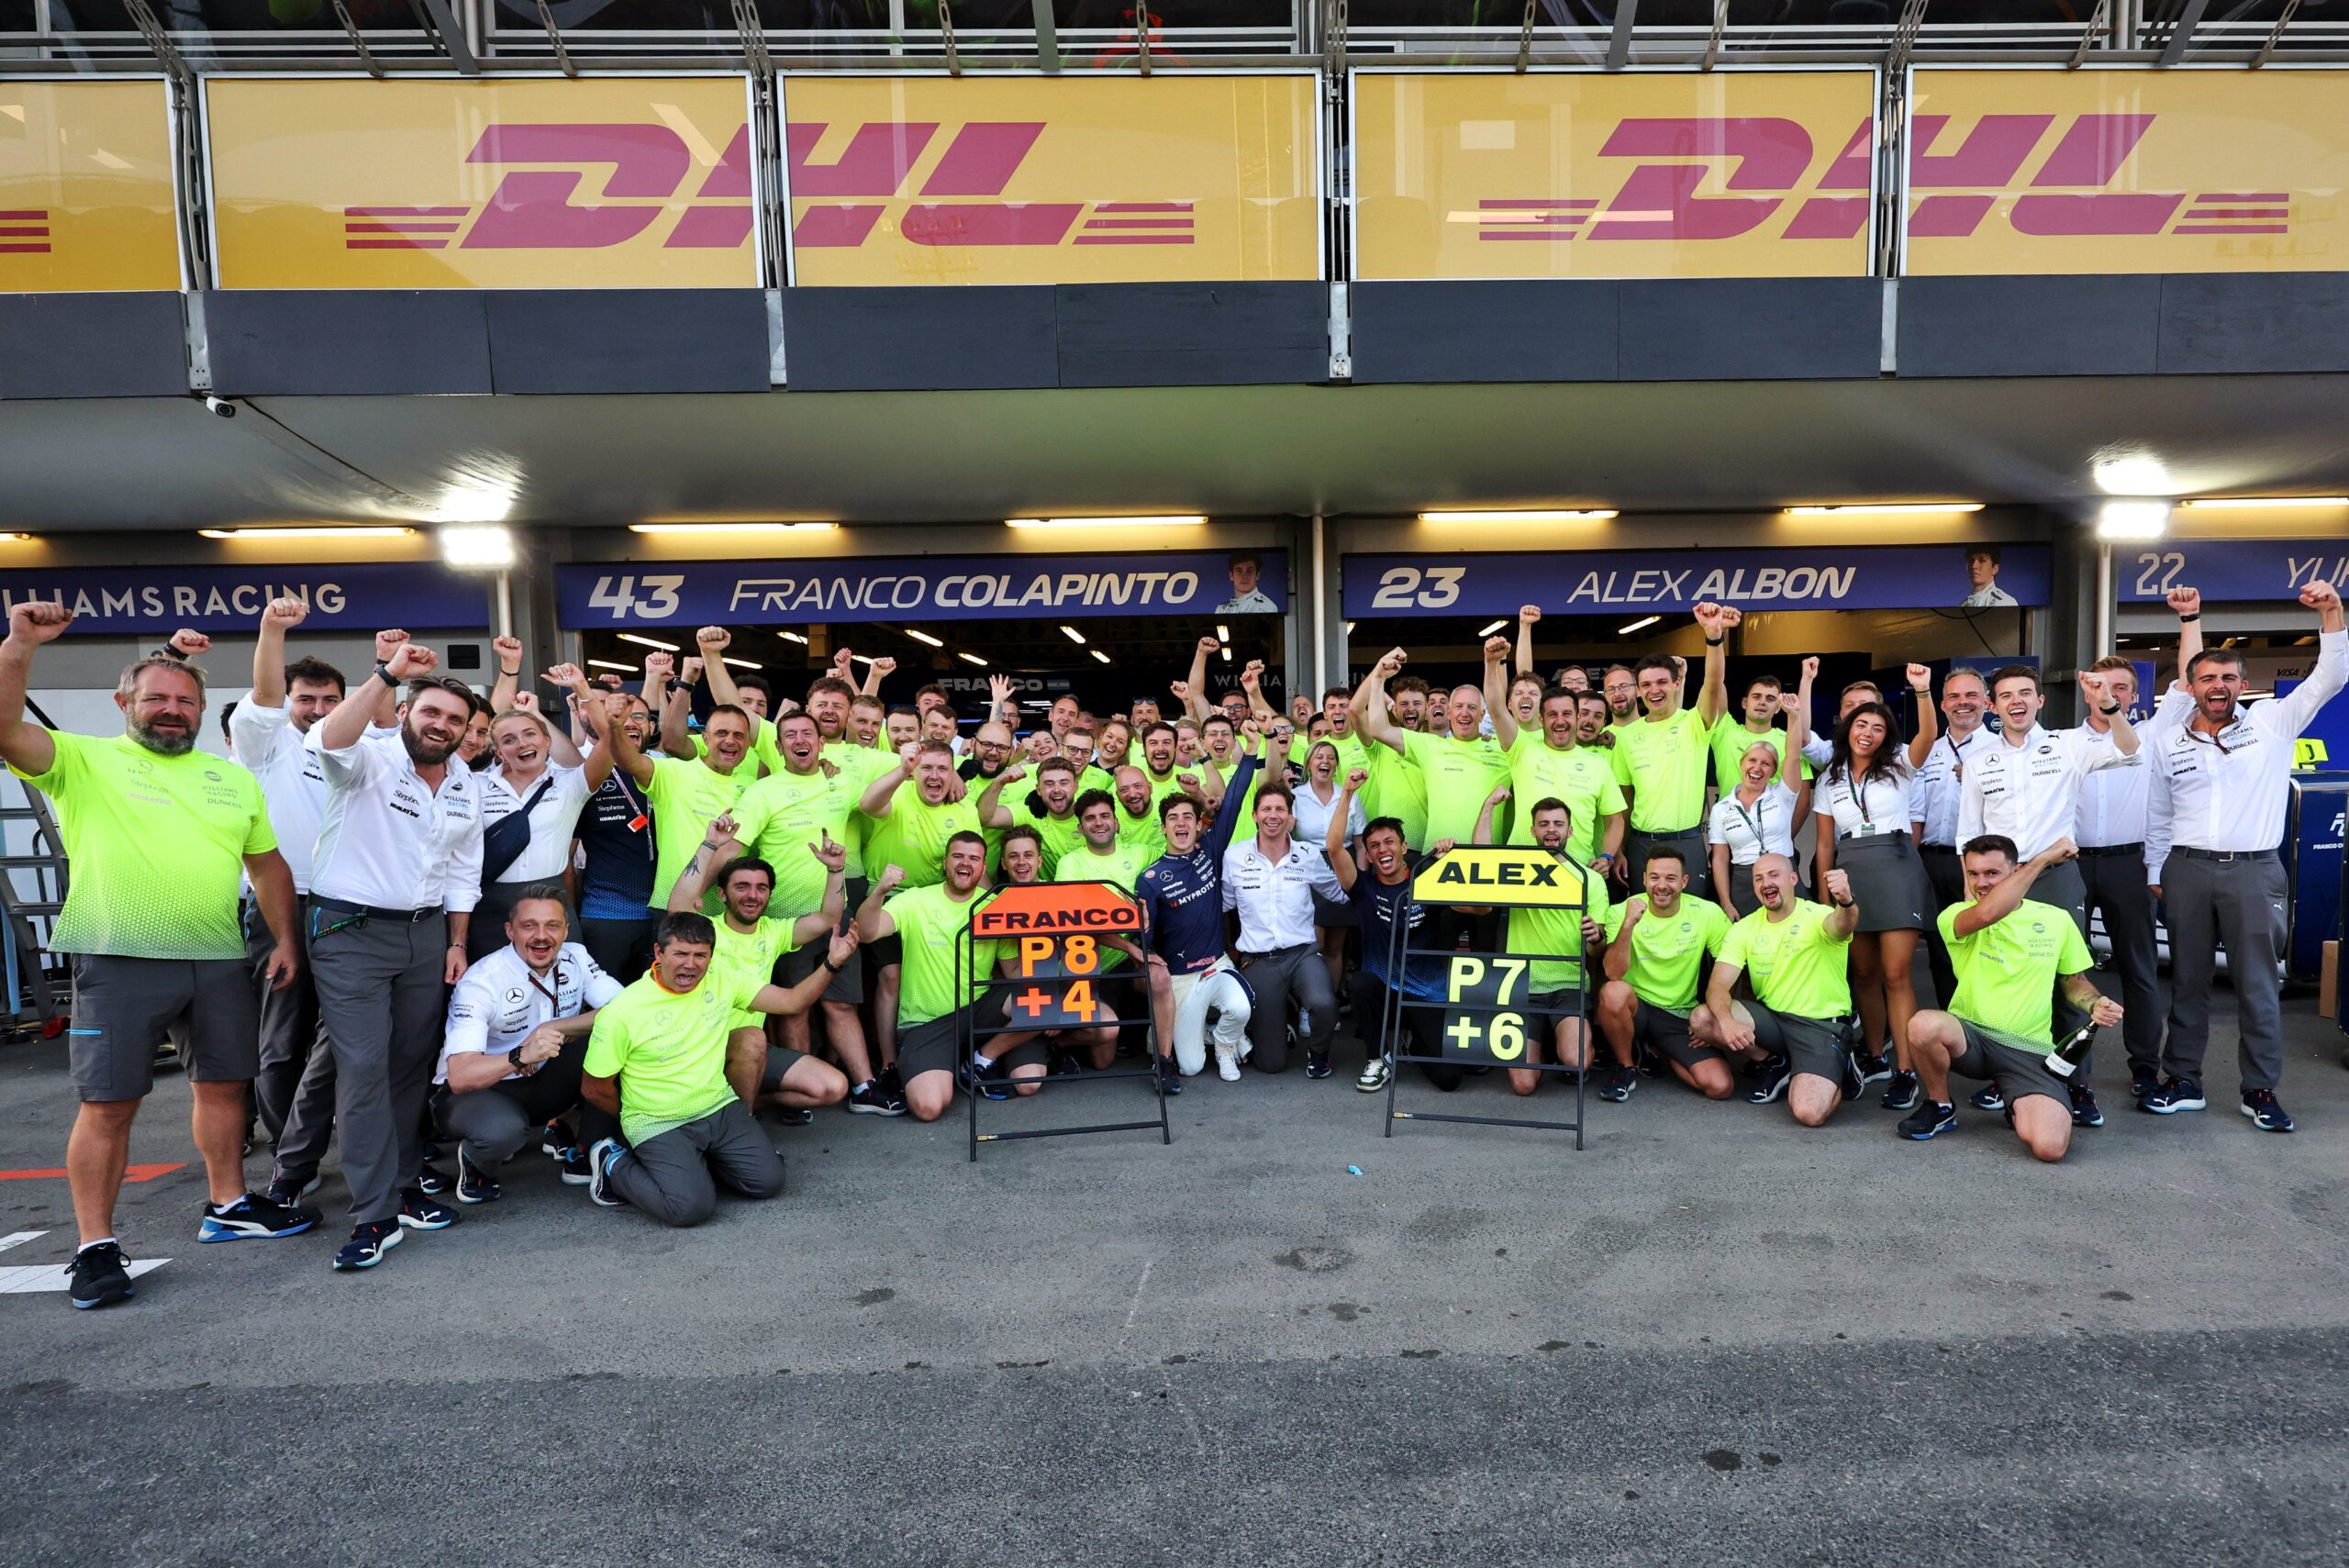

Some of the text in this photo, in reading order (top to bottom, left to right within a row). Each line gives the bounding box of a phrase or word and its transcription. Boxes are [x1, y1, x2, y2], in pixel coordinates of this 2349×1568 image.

[459, 122, 1085, 249] DHL
[1586, 114, 2188, 239] DHL
[2136, 552, 2186, 595] 22
[729, 572, 1198, 612] FRANCO COLAPINTO
[1372, 567, 1466, 608] 23
[1566, 566, 1856, 604] ALEX ALBON
[588, 575, 685, 618] 43
[2277, 668, 2299, 677] VISA
[938, 678, 1043, 692] FRACO
[2222, 726, 2254, 740] WILLIAMS
[2031, 755, 2062, 764] WILLIAMS
[2032, 769, 2062, 777] DURACELL
[393, 789, 420, 806] Stephe
[443, 795, 472, 805] WILLIAMS
[597, 805, 626, 813] Stephens
[1437, 862, 1559, 887] ALEX
[982, 908, 1134, 929] FRANCO
